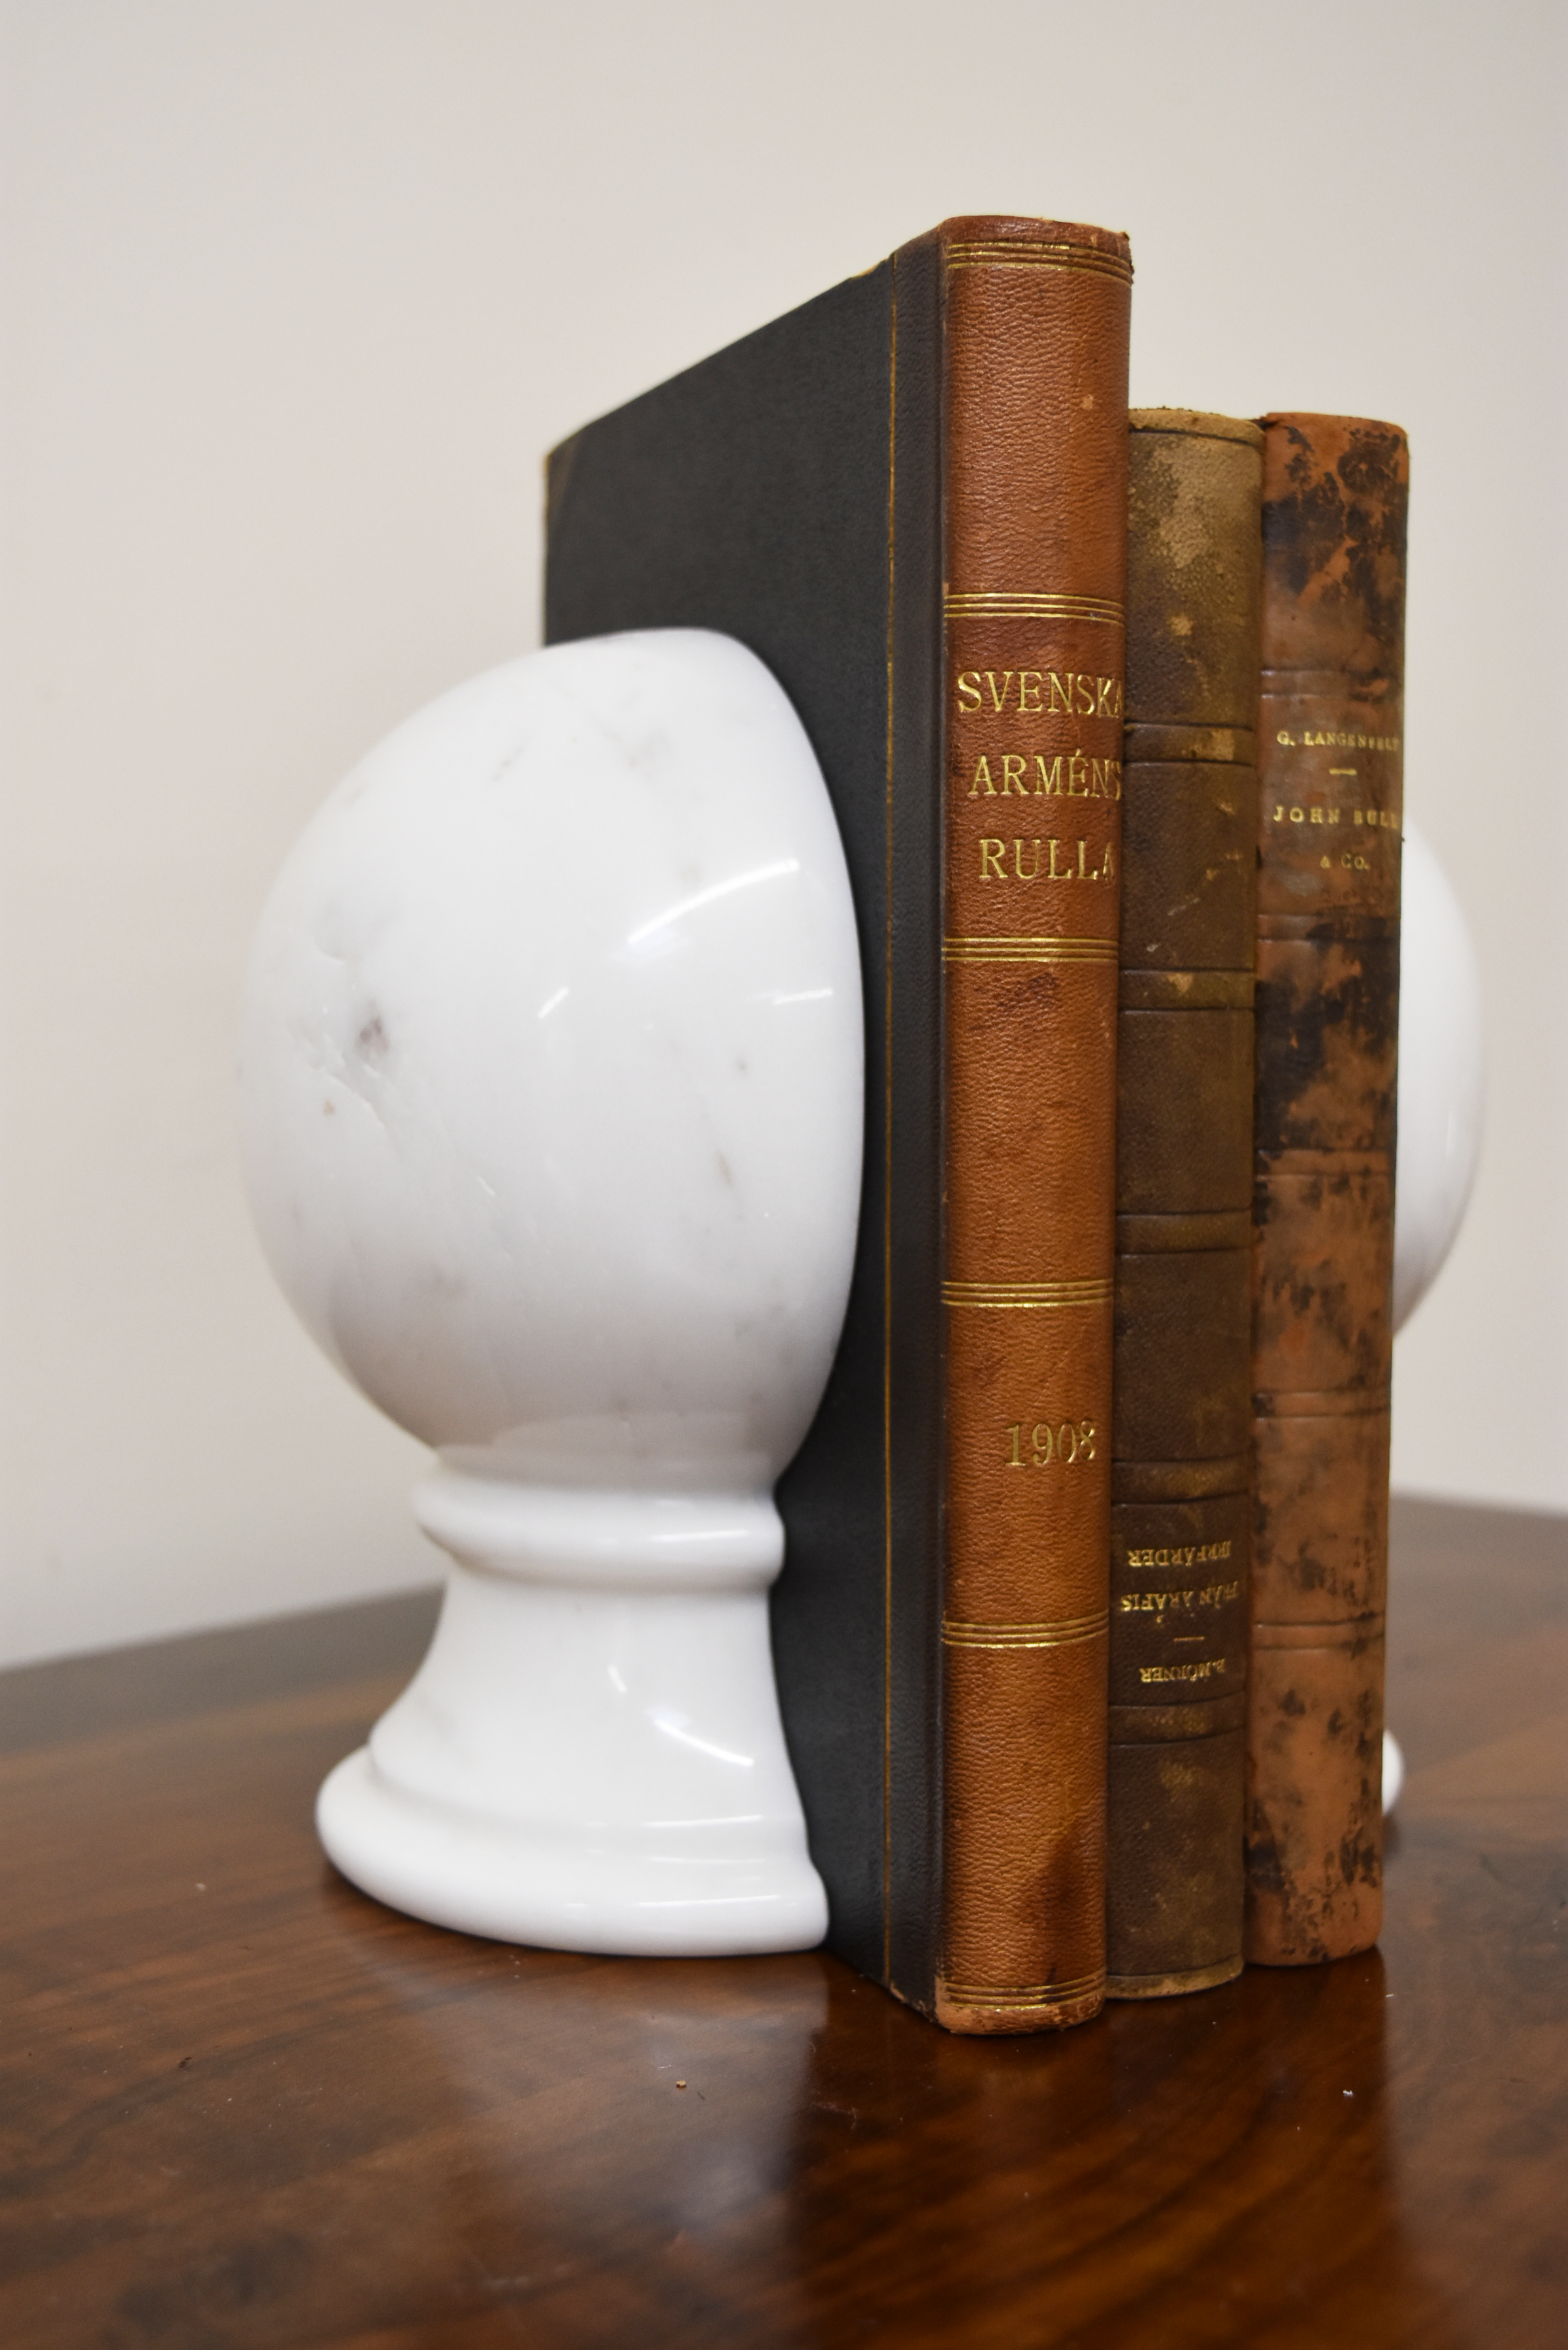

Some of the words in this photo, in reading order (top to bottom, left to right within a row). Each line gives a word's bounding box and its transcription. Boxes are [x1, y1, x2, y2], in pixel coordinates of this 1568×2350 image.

[957, 670, 1122, 719] SVENSKA
[1277, 730, 1296, 747] G.
[968, 748, 1122, 801] ARMÉNS
[1273, 806, 1339, 824] JOHN
[1354, 809, 1398, 830] BULL
[979, 838, 1116, 880] RULLA
[1341, 853, 1370, 870] CO.
[1005, 1420, 1096, 1466] 1908
